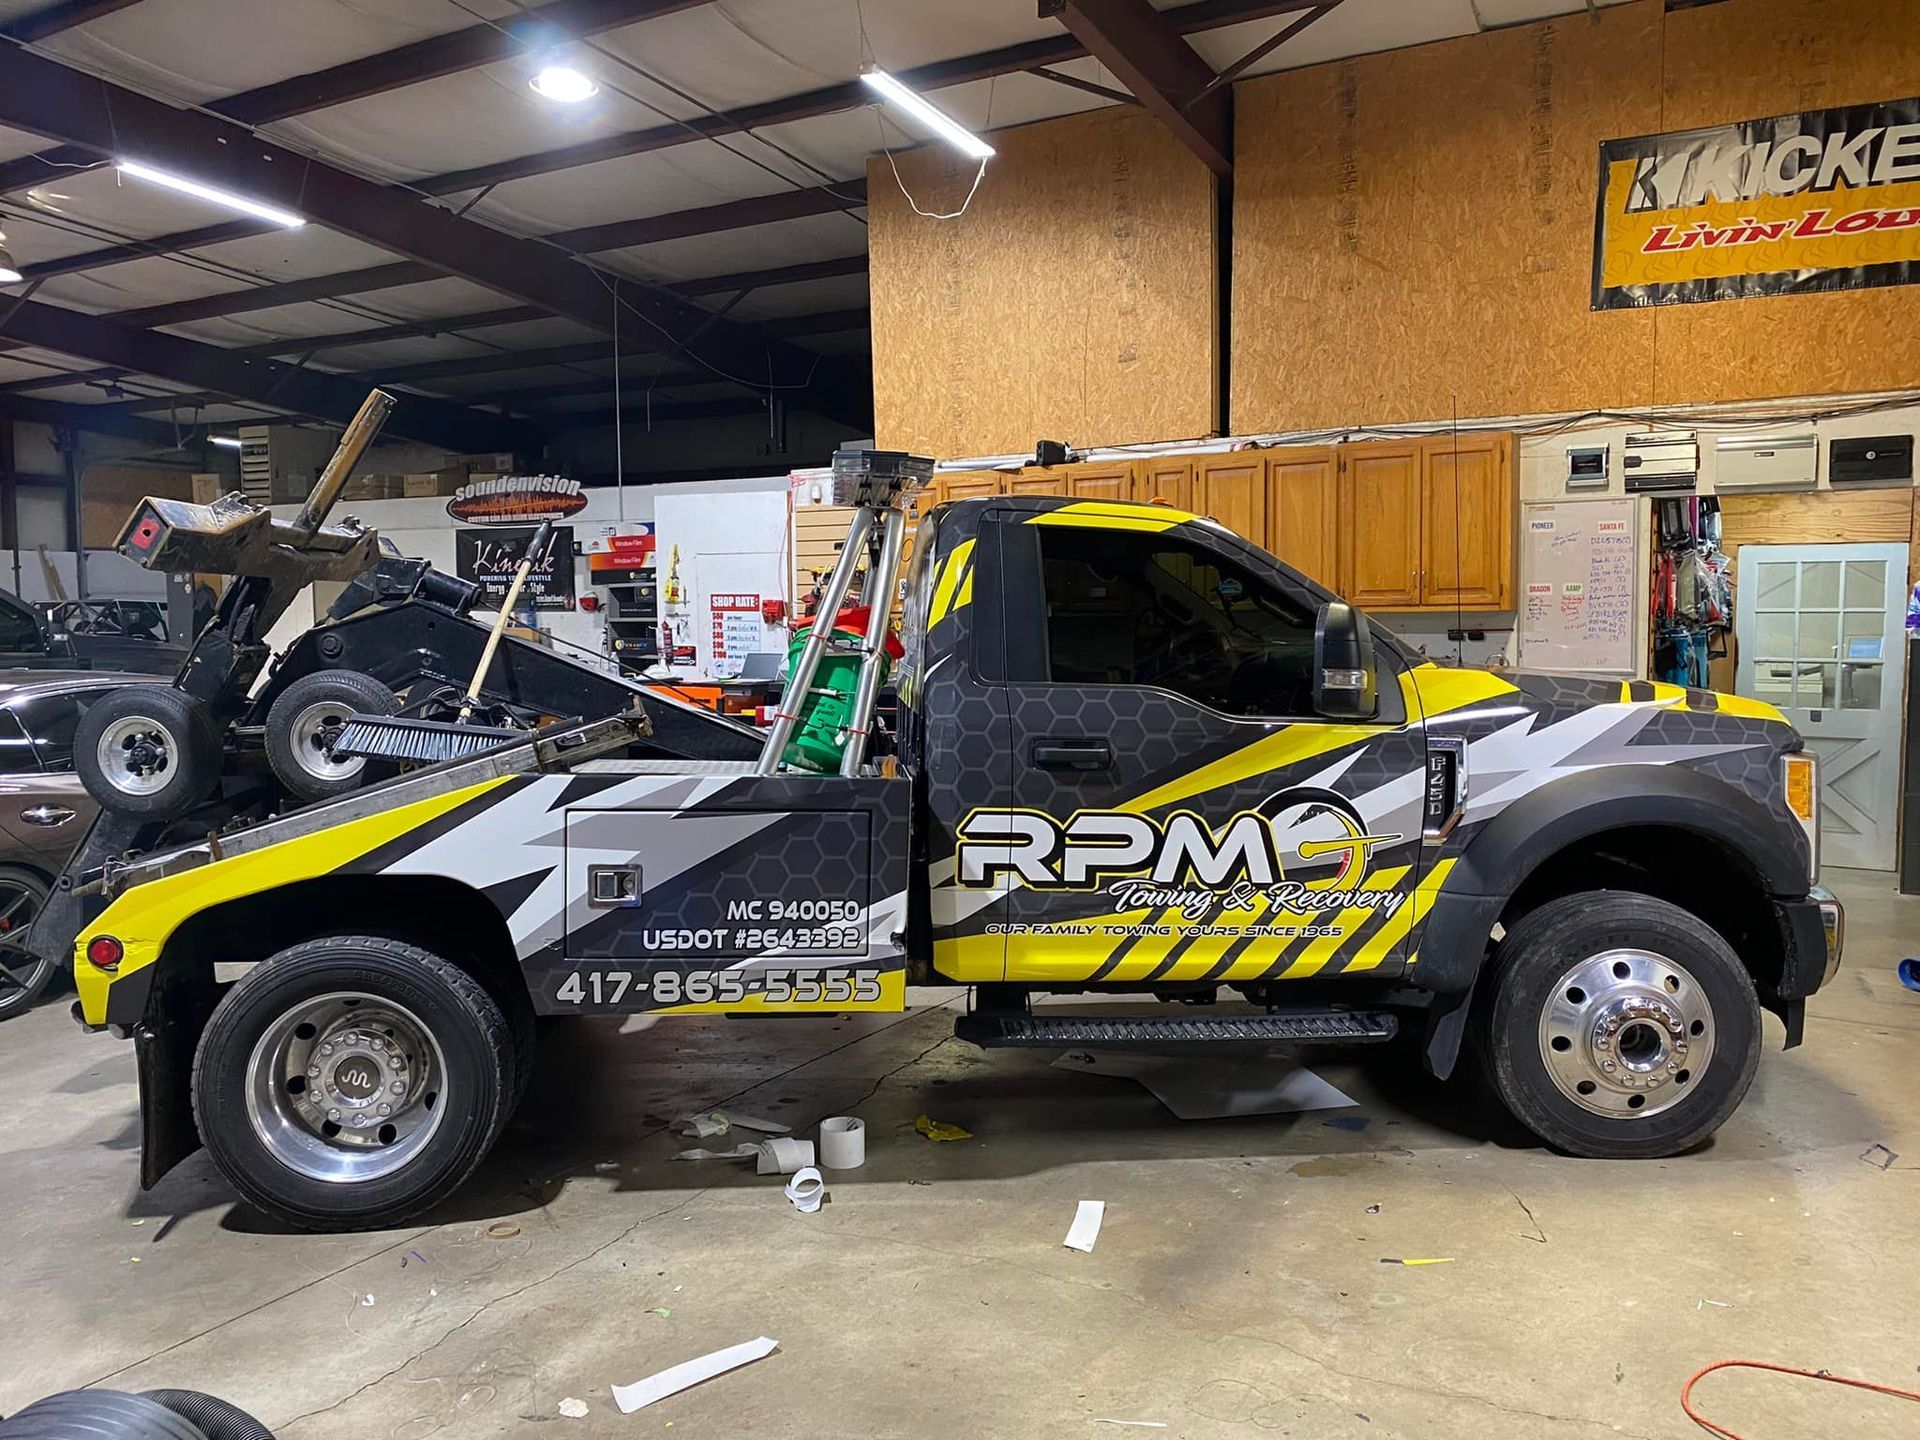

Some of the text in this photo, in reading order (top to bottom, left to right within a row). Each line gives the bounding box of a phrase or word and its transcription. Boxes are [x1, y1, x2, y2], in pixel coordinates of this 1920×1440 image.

[455, 474, 581, 501] soundenvision
[1531, 522, 1554, 530] PIONEER
[1599, 522, 1625, 531] SANTA FE
[472, 531, 558, 574] Kineik
[486, 582, 505, 595] Energy
[530, 582, 545, 595] Style
[1529, 585, 1551, 593] DRAGON
[1565, 584, 1582, 592] AAMP
[712, 595, 759, 608] SHOP RATE:
[957, 809, 1280, 889] RPM
[1096, 878, 1406, 920] Towing & Recovery
[726, 900, 861, 921] MC 940050
[642, 927, 861, 951] USDOT #2643392
[985, 923, 1344, 938] OUR FAMILY TOWING YOURS SINCE 1965
[555, 969, 882, 1004] 417-865-5555
